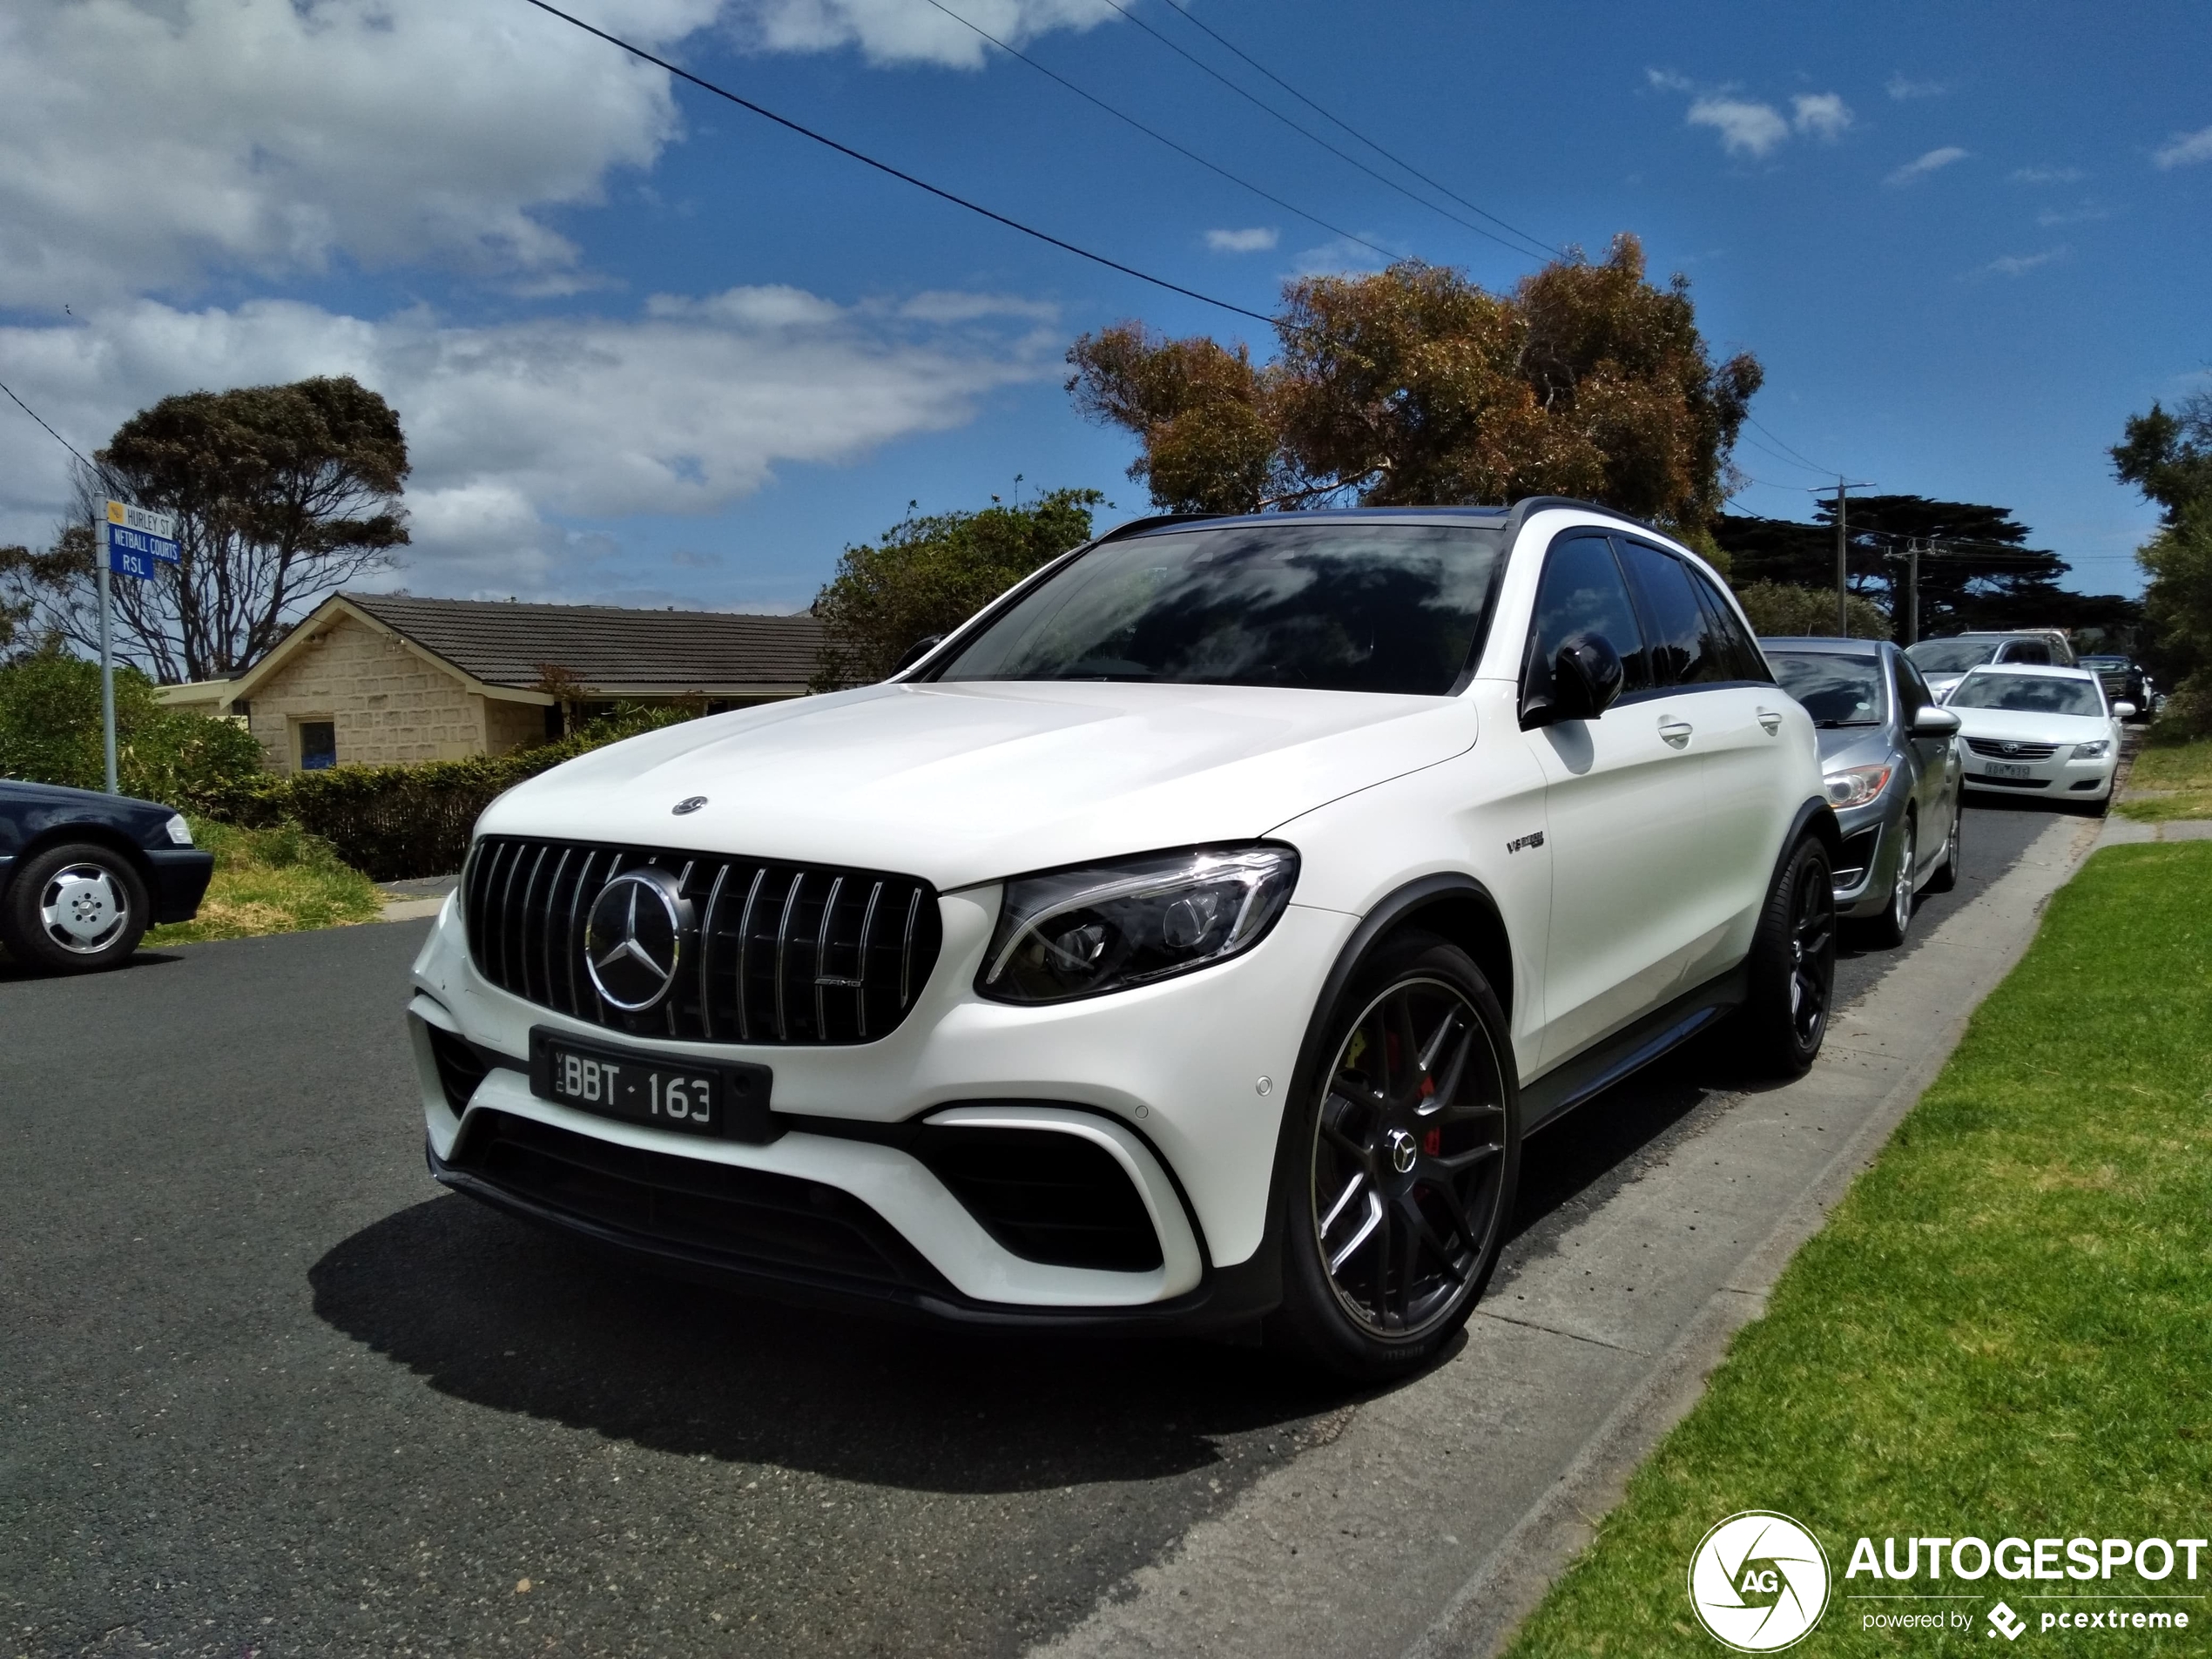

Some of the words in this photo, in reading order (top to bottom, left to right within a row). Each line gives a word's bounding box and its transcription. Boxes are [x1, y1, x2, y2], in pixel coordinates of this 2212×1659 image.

[127, 509, 158, 531] HURLEY
[160, 519, 170, 536] ST
[114, 528, 148, 553] NETBALL
[150, 538, 178, 561] COURTS
[123, 554, 145, 575] RSL
[828, 979, 861, 988] AMG
[556, 1052, 564, 1093] VIC
[564, 1055, 620, 1105] BBT
[649, 1072, 710, 1123] 163
